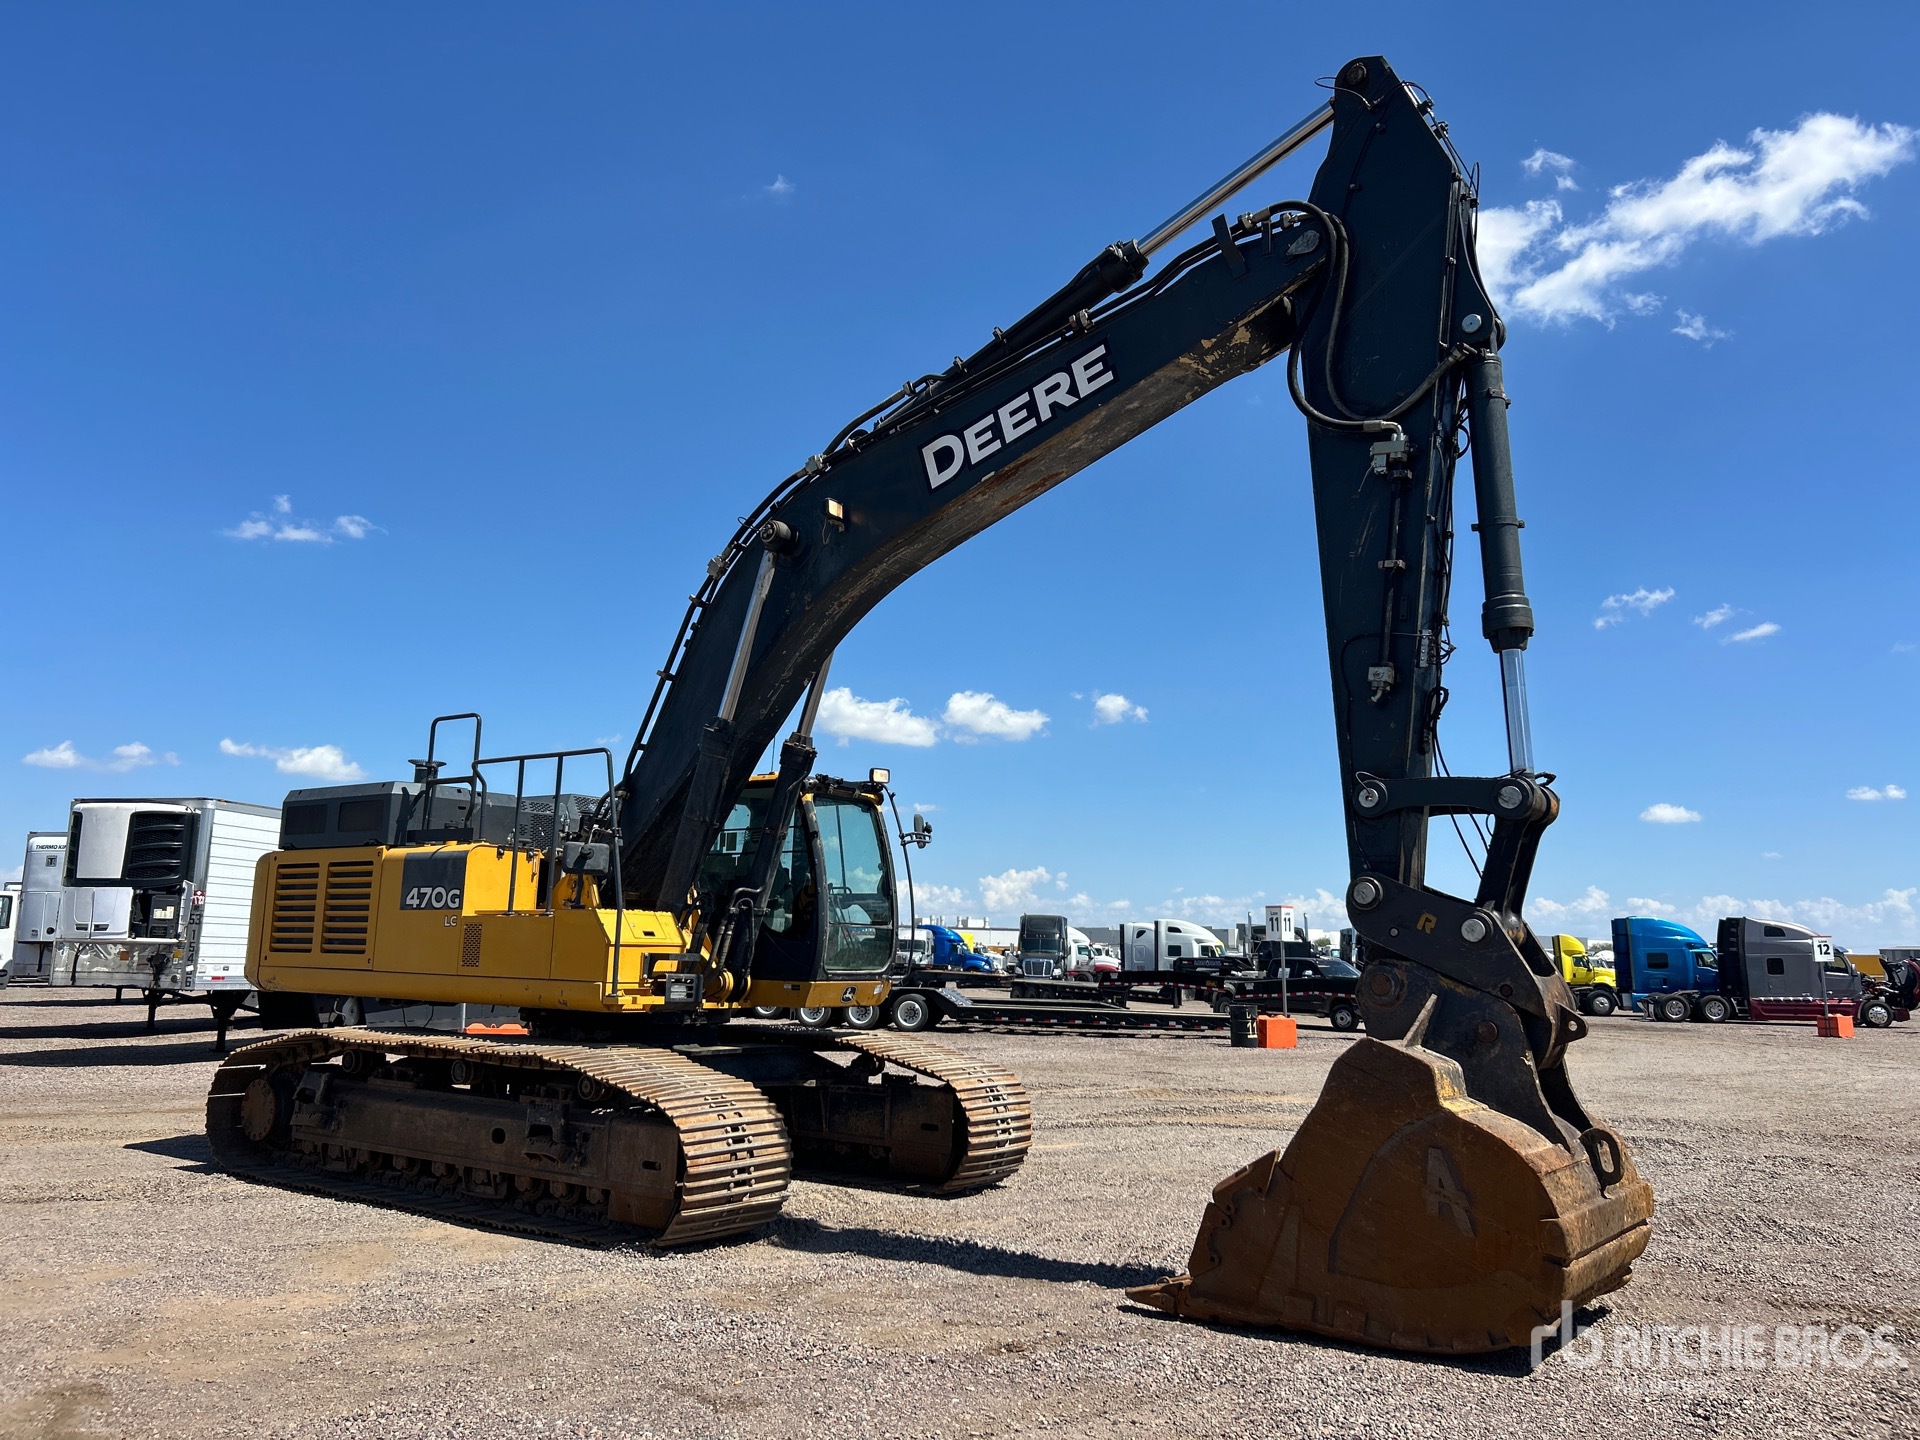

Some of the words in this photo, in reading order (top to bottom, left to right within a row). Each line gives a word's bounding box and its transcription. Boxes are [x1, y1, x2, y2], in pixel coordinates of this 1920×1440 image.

[921, 343, 1115, 490] DEERE
[405, 886, 461, 909] 470G
[189, 913, 201, 925] 53
[443, 915, 458, 927] LC
[1269, 916, 1279, 932] 11
[1284, 917, 1291, 932] 11
[1416, 912, 1438, 935] R
[1817, 944, 1831, 955] 12
